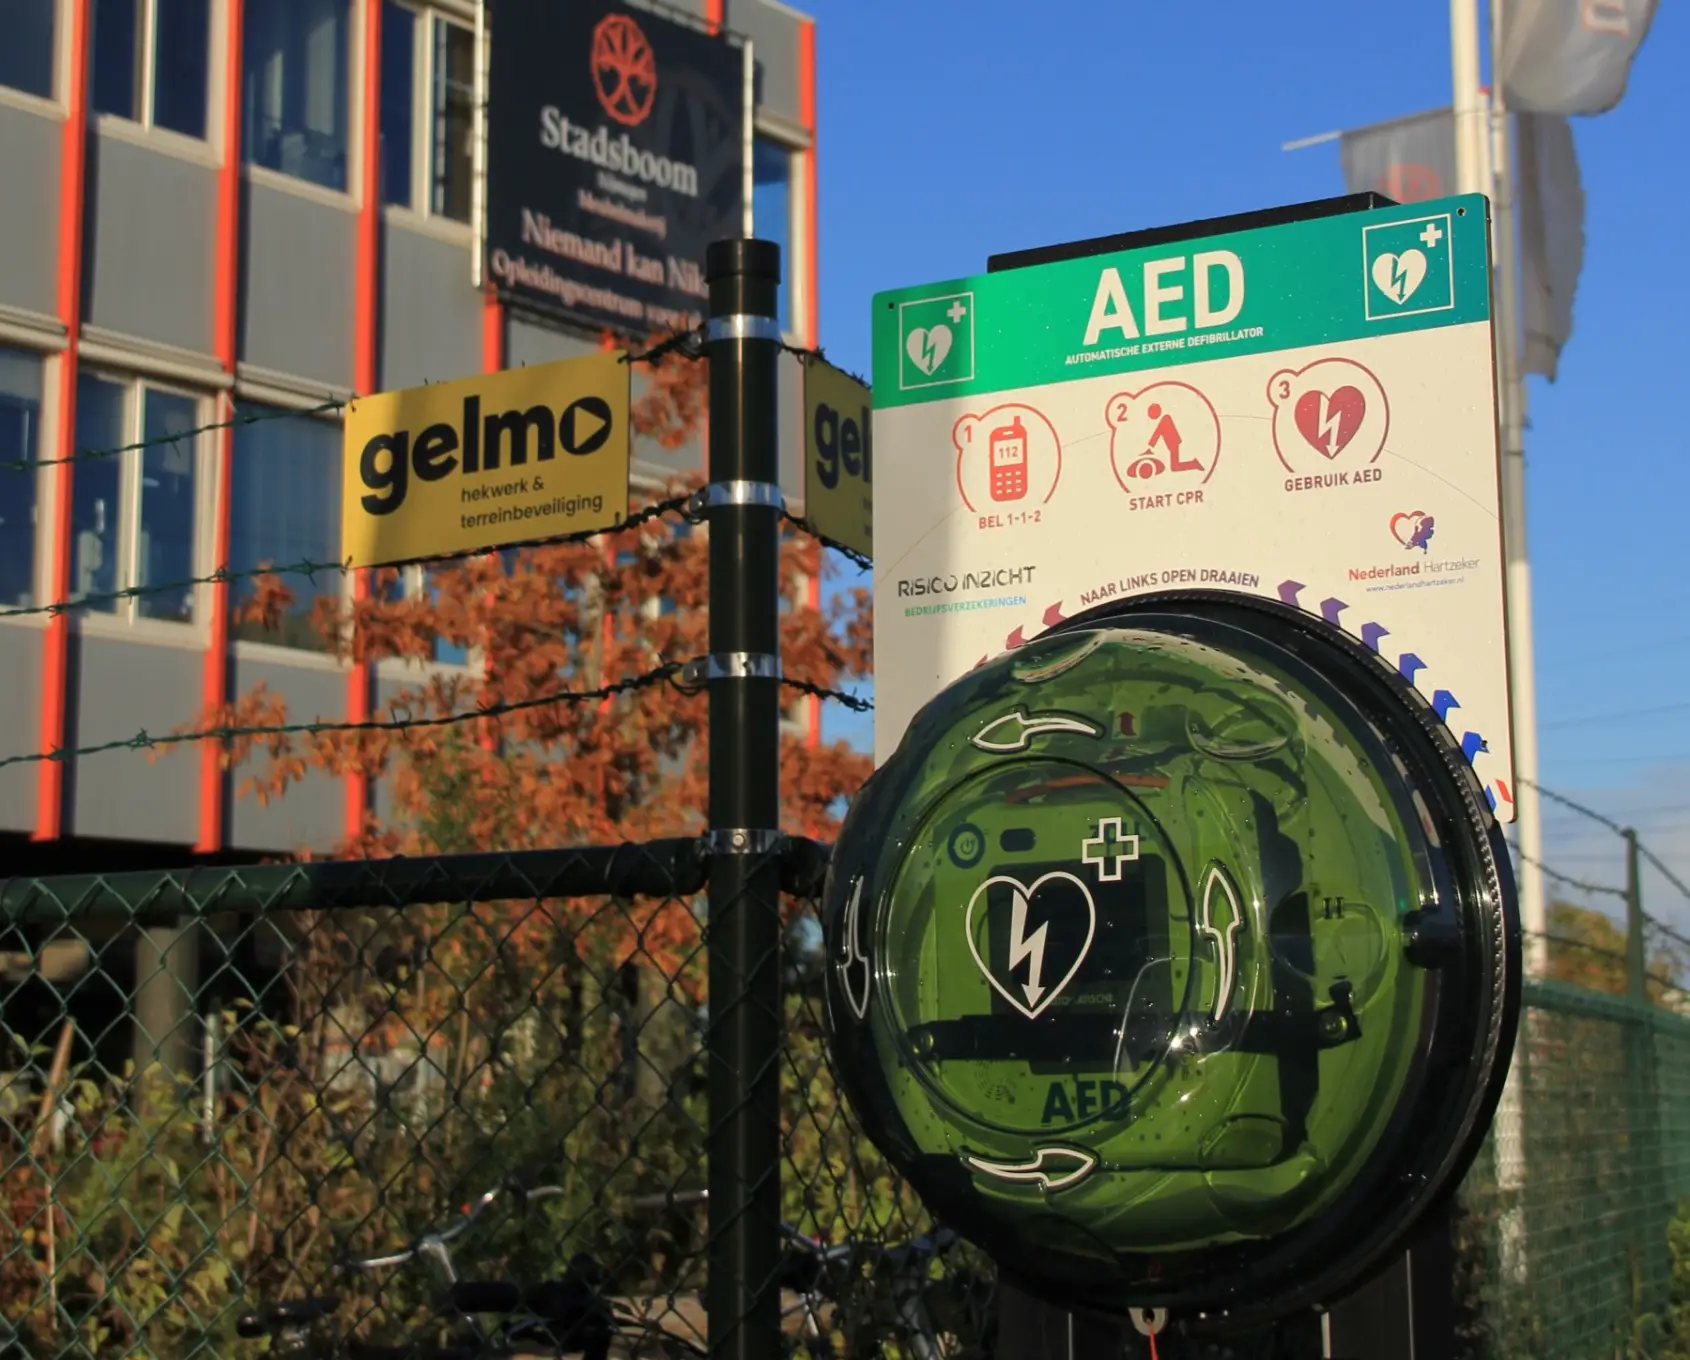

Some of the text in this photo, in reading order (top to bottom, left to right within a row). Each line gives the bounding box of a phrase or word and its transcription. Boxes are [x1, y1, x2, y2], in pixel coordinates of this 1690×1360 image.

[540, 104, 698, 197] Stadsboom
[522, 207, 622, 273] Niemand
[625, 241, 664, 285] kan
[1083, 249, 1245, 346] AED
[1065, 326, 1264, 366] AUTOMATISCHE EXTERNE DEFIBRILLATOR
[1278, 380, 1291, 399] 3
[1117, 403, 1128, 422] 2
[815, 402, 872, 490] gel
[964, 424, 972, 443] 1
[360, 395, 612, 516] gelmo
[999, 446, 1019, 459] 112
[461, 476, 545, 503] hekwerk &
[1284, 468, 1382, 492] GEBRUIK AED
[461, 494, 603, 529] terreinbeveiliging
[1128, 490, 1204, 511] START CPR
[978, 510, 1041, 530] BEL 1-1-2
[1348, 556, 1480, 581] Nederland Hartzeker
[1080, 568, 1260, 606] NAAR LINKS OPEN DRAAIEN
[1366, 576, 1464, 593] www.nederlandhartzeker.nl
[904, 595, 1027, 617] BEDRIJFSVERZEKERINGEN
[1041, 1079, 1132, 1123] AED
